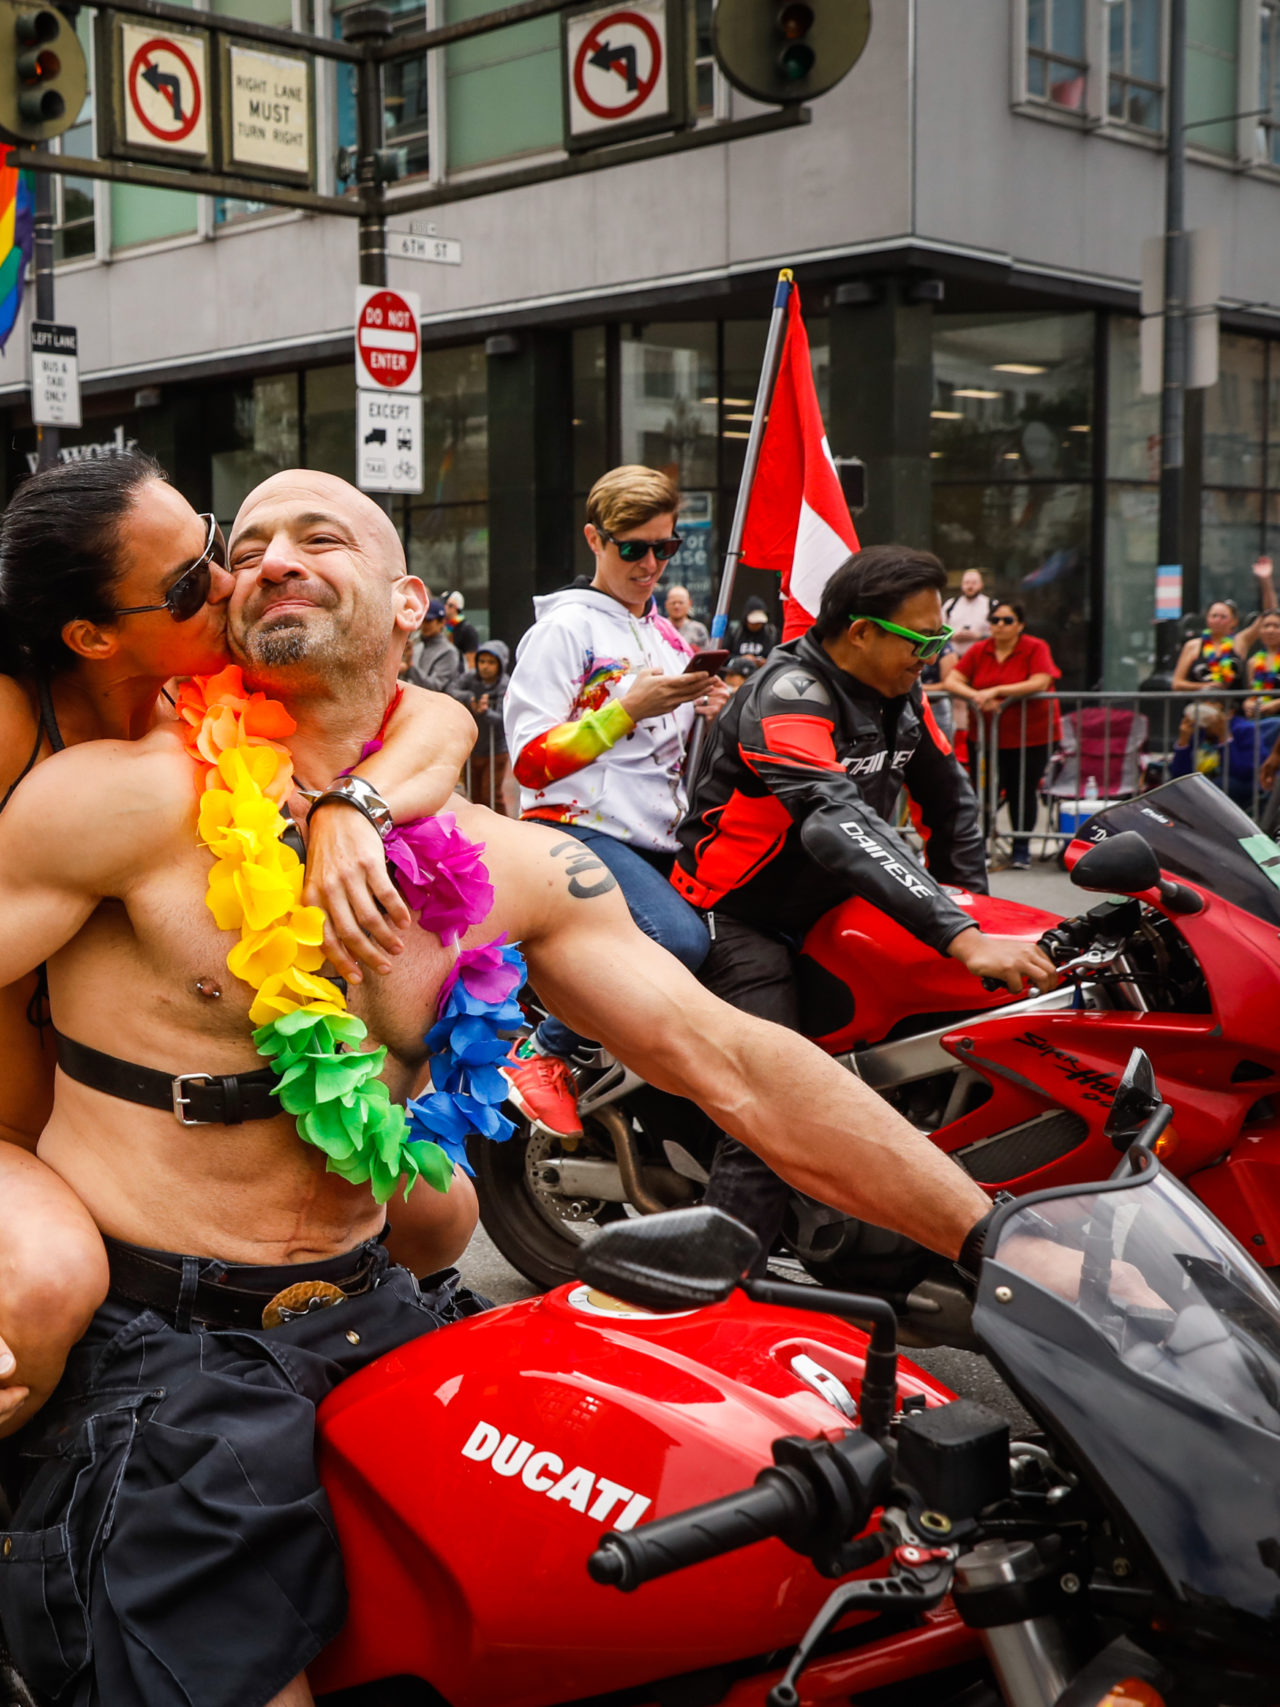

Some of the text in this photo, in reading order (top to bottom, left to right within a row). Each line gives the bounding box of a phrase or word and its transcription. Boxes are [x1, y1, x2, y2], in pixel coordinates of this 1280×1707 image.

[236, 74, 303, 102] RIGHT LANE
[249, 98, 290, 124] MUST
[238, 121, 304, 147] TURN RIGHT
[402, 239, 448, 258] 6TH ST
[365, 306, 410, 328] DO NOT
[53, 334, 76, 350] LANE
[42, 360, 68, 373] BUS &
[370, 351, 408, 371] ENTER
[45, 389, 67, 403] ONLY
[368, 402, 410, 420] EXCEPT
[839, 821, 935, 899] DAINESE
[461, 1420, 652, 1533] DUCATI
